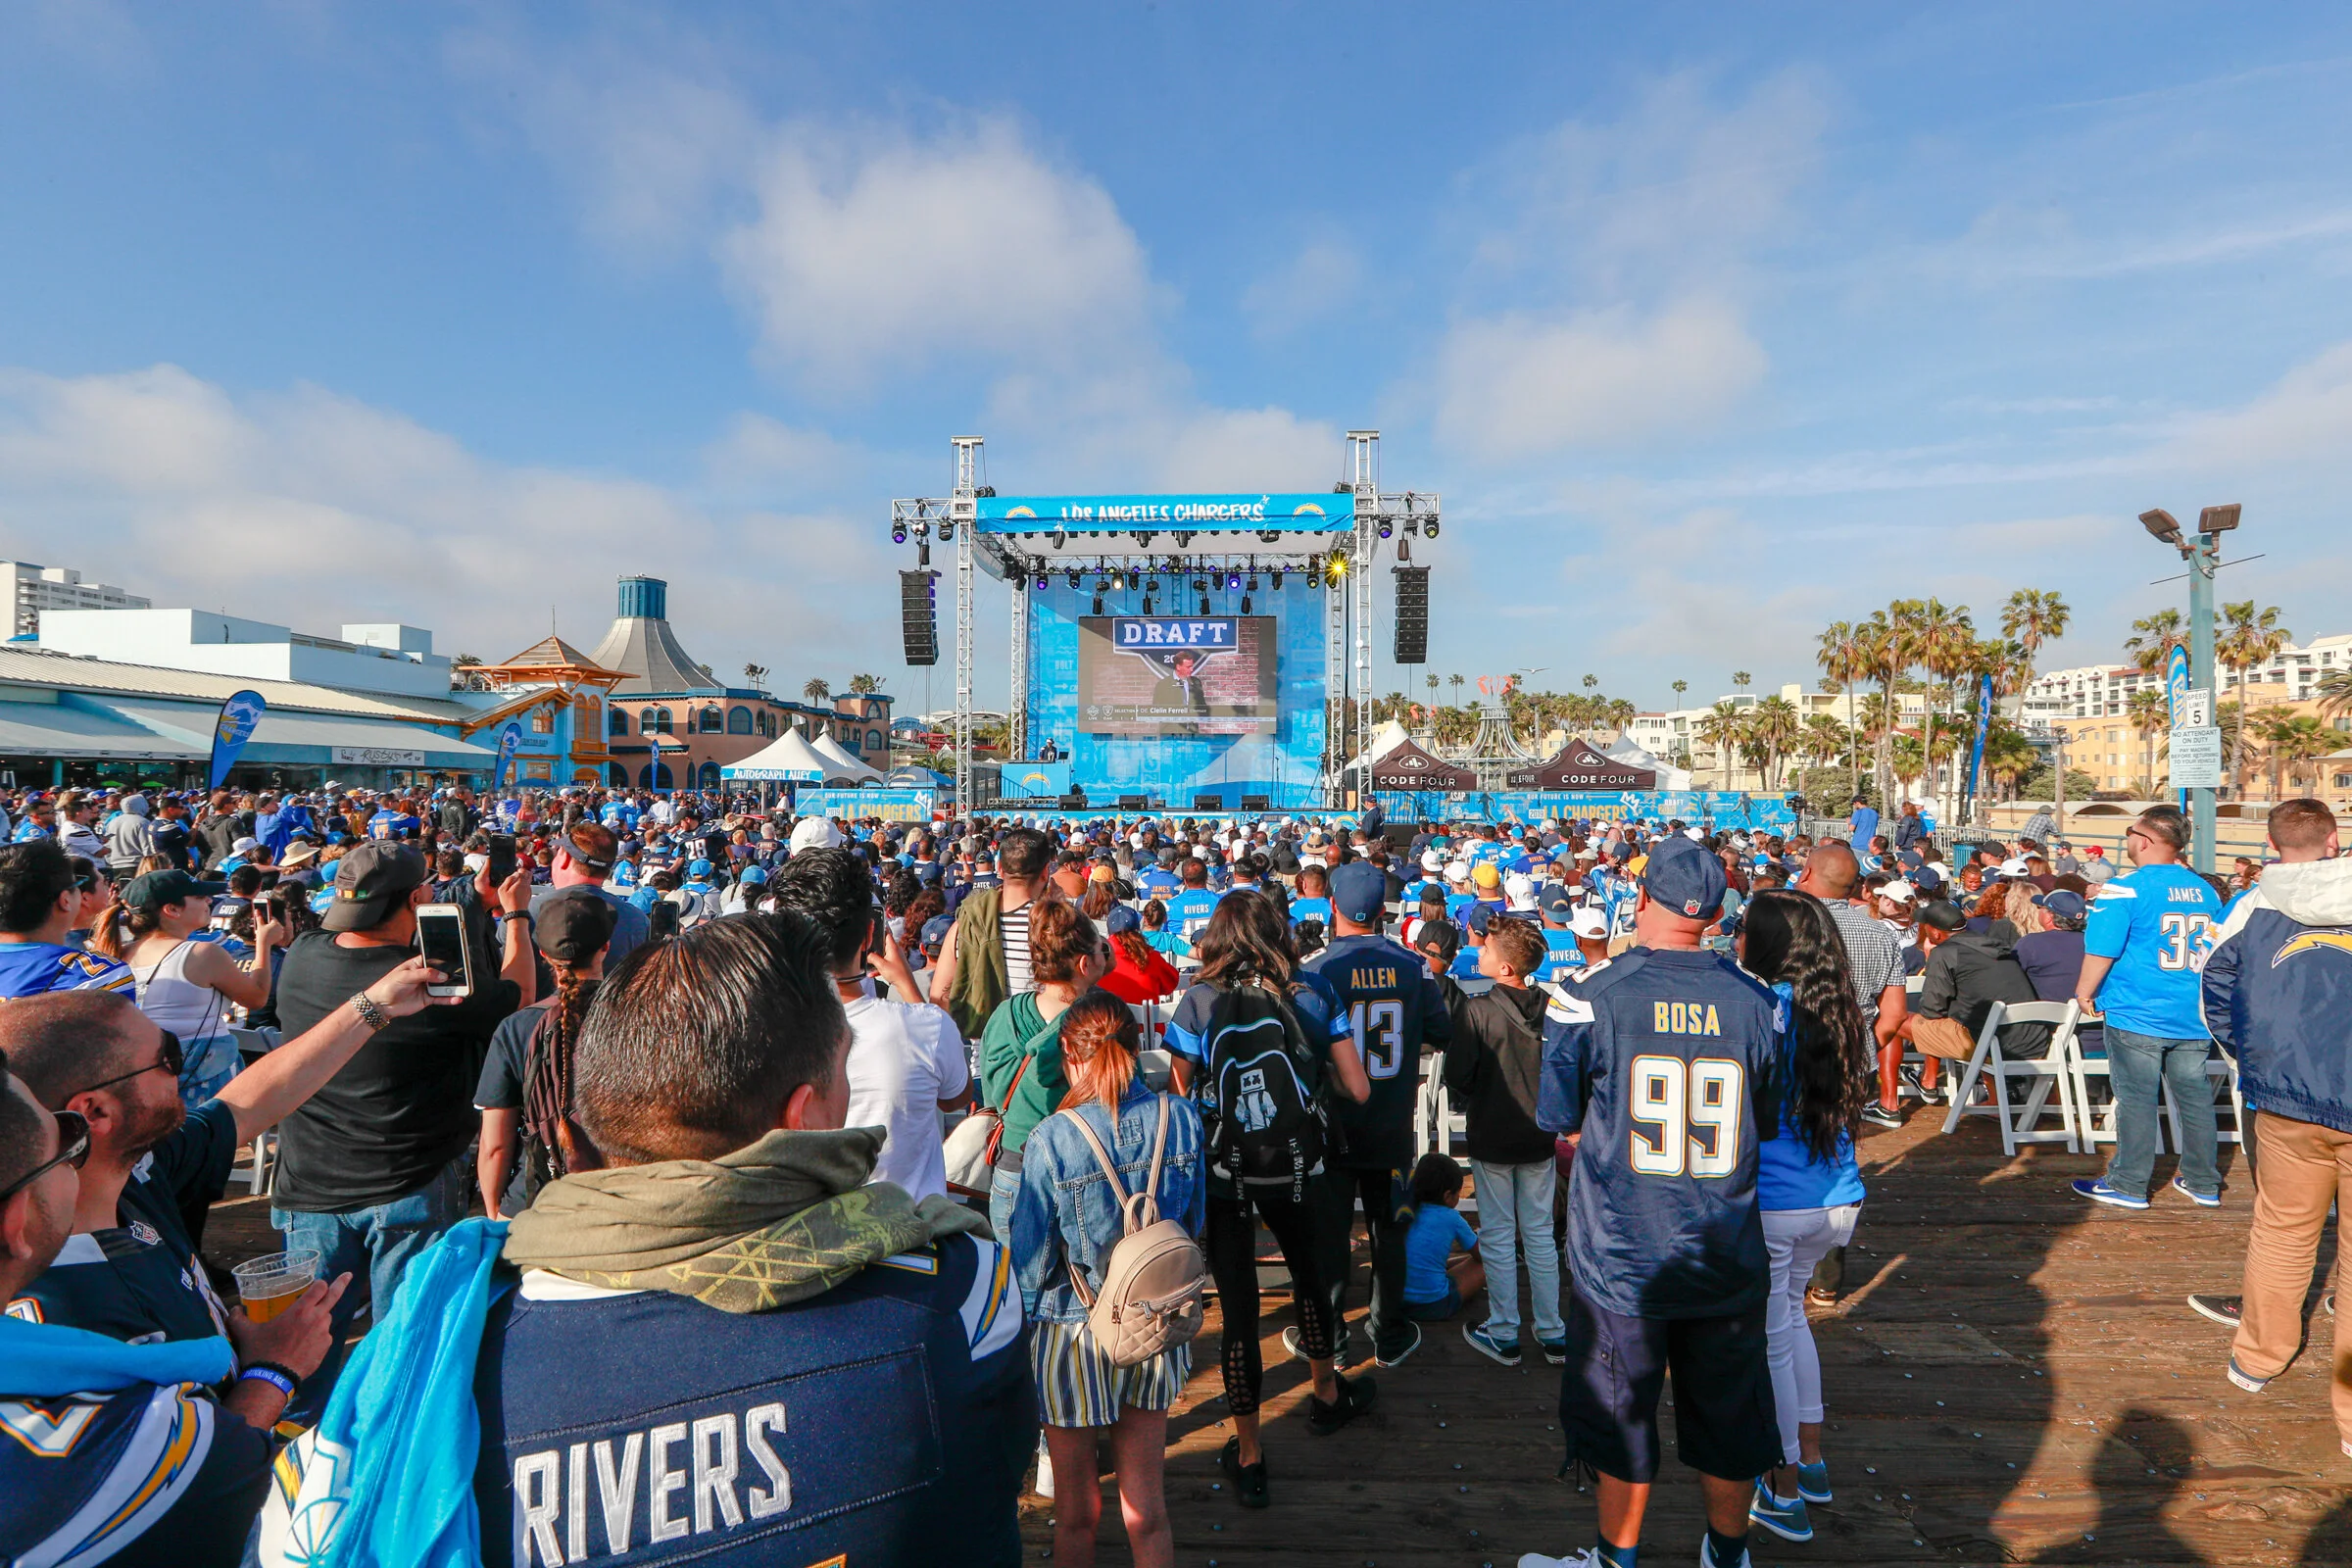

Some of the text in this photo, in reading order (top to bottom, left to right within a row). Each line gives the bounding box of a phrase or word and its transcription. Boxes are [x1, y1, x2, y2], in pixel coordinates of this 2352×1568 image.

[1061, 502, 1265, 523] LOS ANGELES CHARGERS
[1123, 622, 1228, 644] DRAFT
[1163, 654, 1176, 663] 20
[2193, 710, 2202, 724] 5
[734, 768, 811, 781] AUTOGRAPH ALLEY
[1379, 775, 1457, 787] CODE FOUR
[1561, 774, 1636, 784] CODE FOUR
[1449, 791, 1466, 802] ASAP
[826, 803, 922, 822] 2019 LA CHARGERS
[1530, 805, 1628, 824] 2019 LA CHARGERS
[685, 838, 708, 860] 28
[972, 881, 991, 890] GATES
[315, 895, 334, 907] RIVER
[2168, 887, 2204, 903] JAMES
[219, 905, 239, 915] GATES
[1184, 904, 1209, 914] RIVERS
[1304, 912, 1324, 921] BOSA
[2159, 912, 2211, 972] 33
[1549, 950, 1582, 962] RIVERS
[1350, 966, 1396, 990] ALLEN
[1653, 1001, 1721, 1037] BOSA
[1348, 999, 1404, 1081] 13
[1630, 1054, 1744, 1179] 99
[273, 1374, 286, 1387] AGE
[514, 1401, 792, 1568] RIVERS
